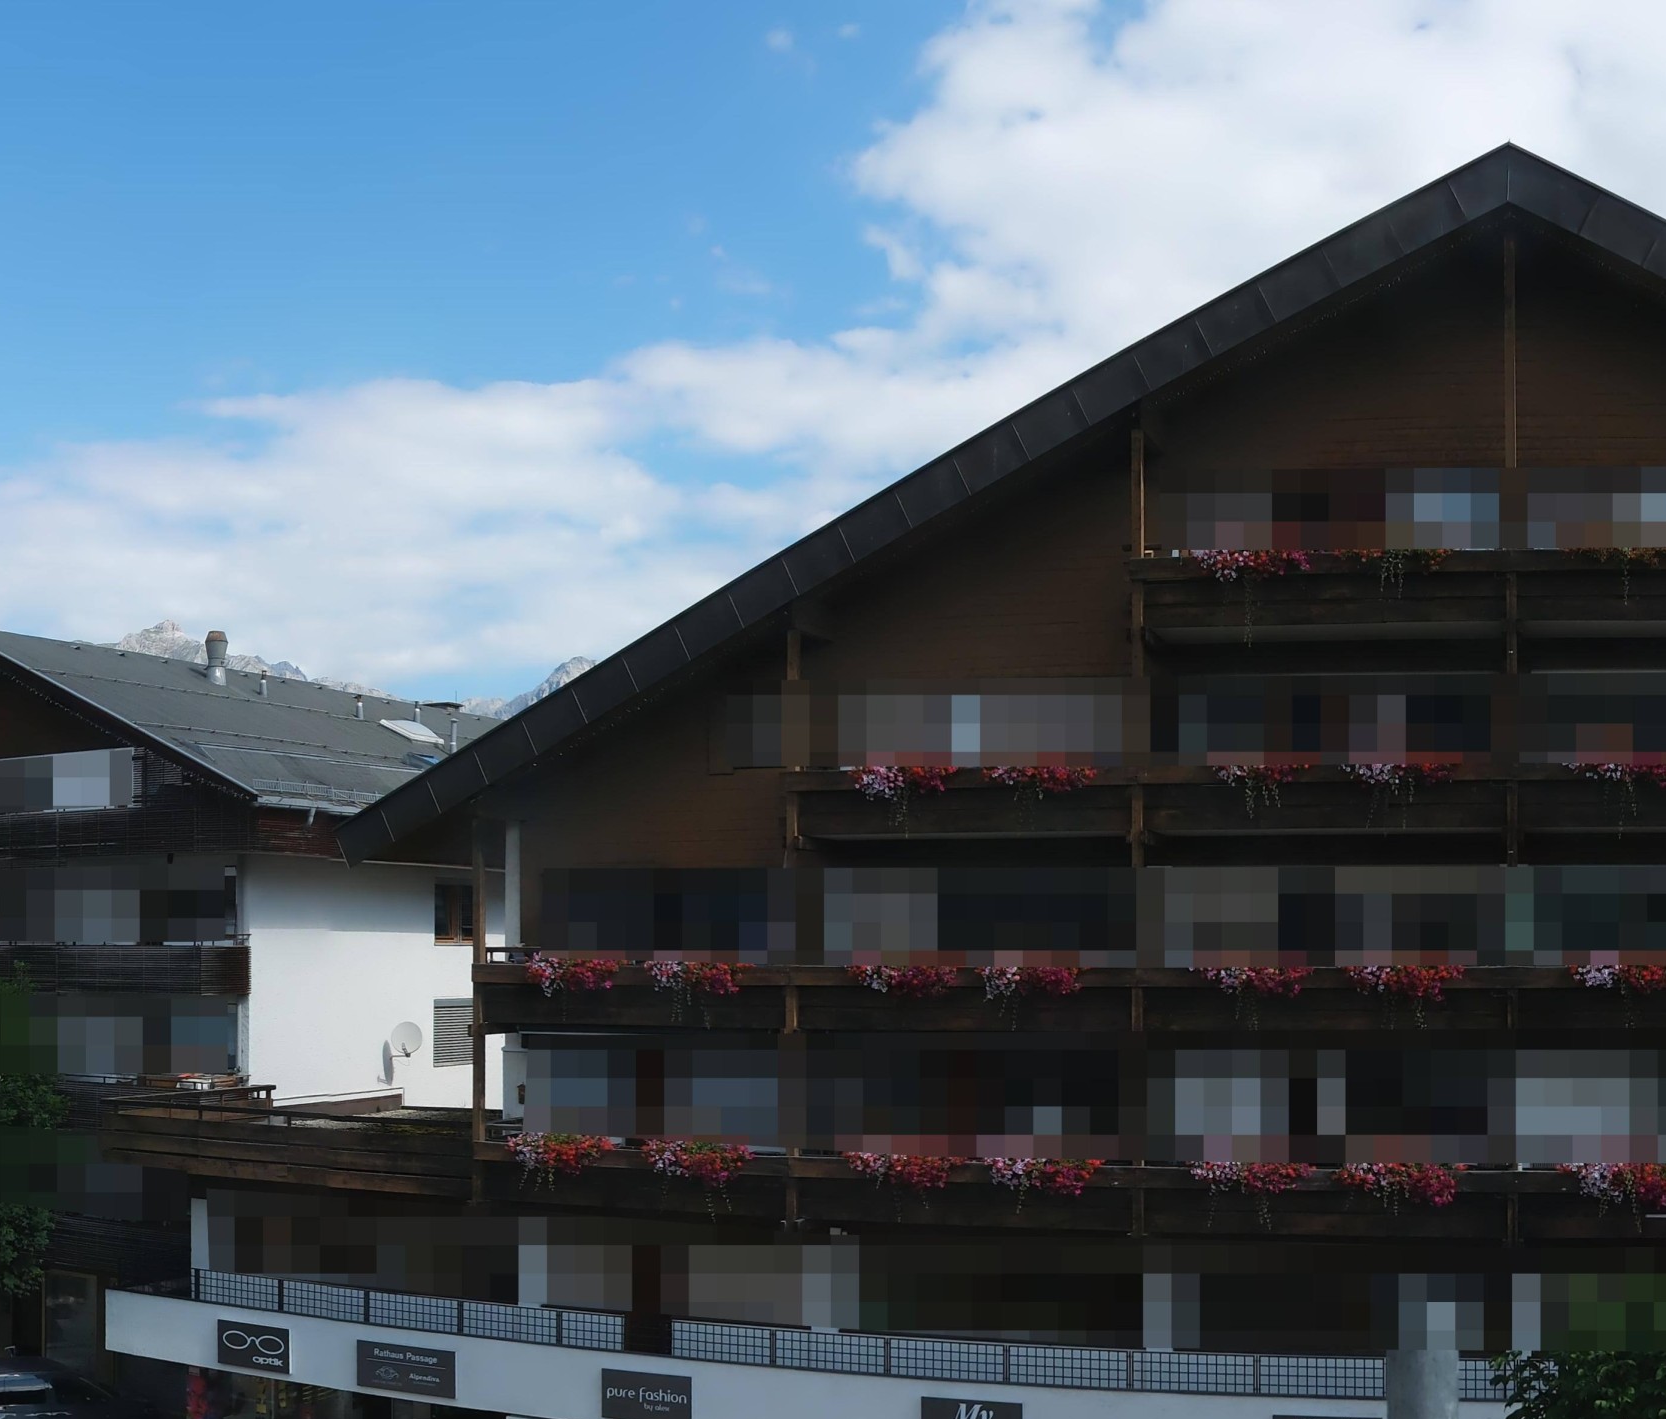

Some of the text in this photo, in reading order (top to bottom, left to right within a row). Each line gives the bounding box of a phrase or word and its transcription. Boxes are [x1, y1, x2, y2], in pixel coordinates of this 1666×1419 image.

[252, 1355, 284, 1367] optik
[373, 1348, 438, 1365] Rathaus Passage
[606, 1387, 687, 1404] pure fashion
[643, 1402, 670, 1412] by alex
